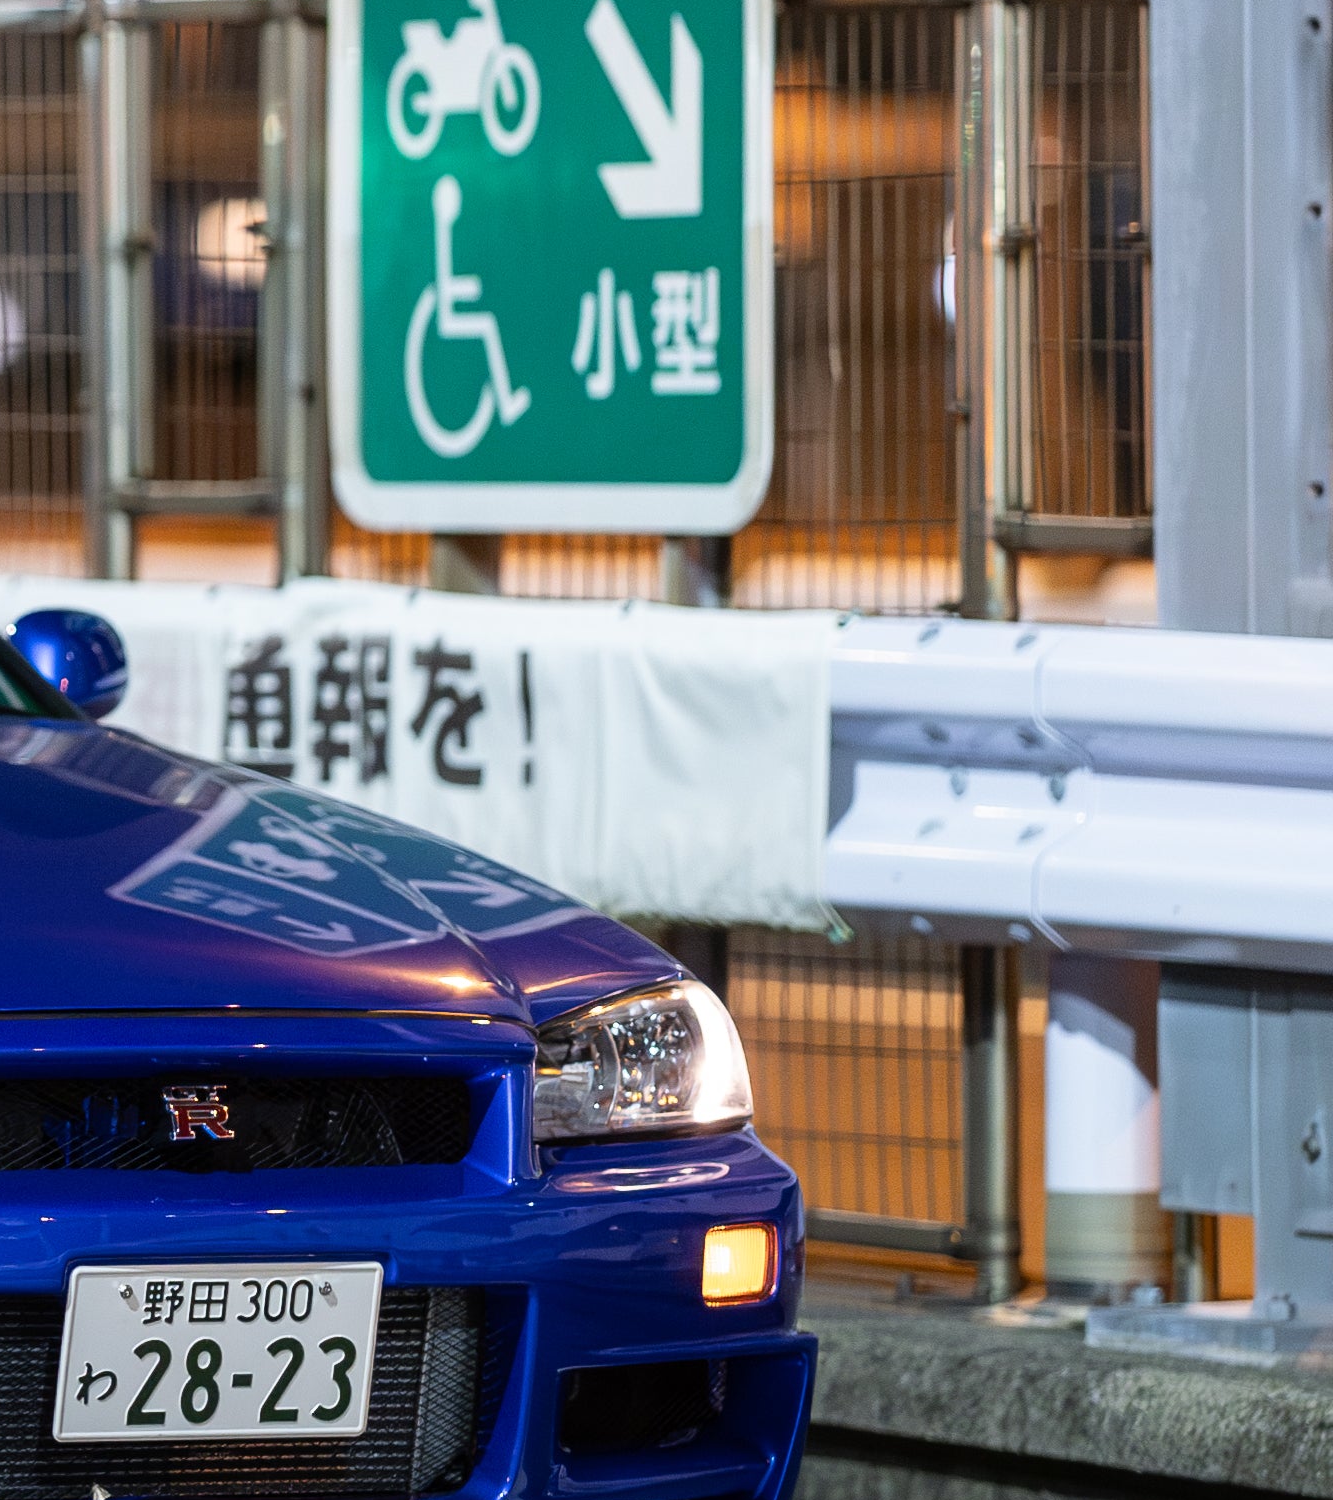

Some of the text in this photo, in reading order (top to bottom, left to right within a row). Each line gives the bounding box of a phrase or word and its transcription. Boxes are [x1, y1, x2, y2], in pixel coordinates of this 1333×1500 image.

[572, 266, 722, 400] 小型
[142, 1278, 314, 1325] 野田 300
[75, 1336, 357, 1427] わ 28-23
